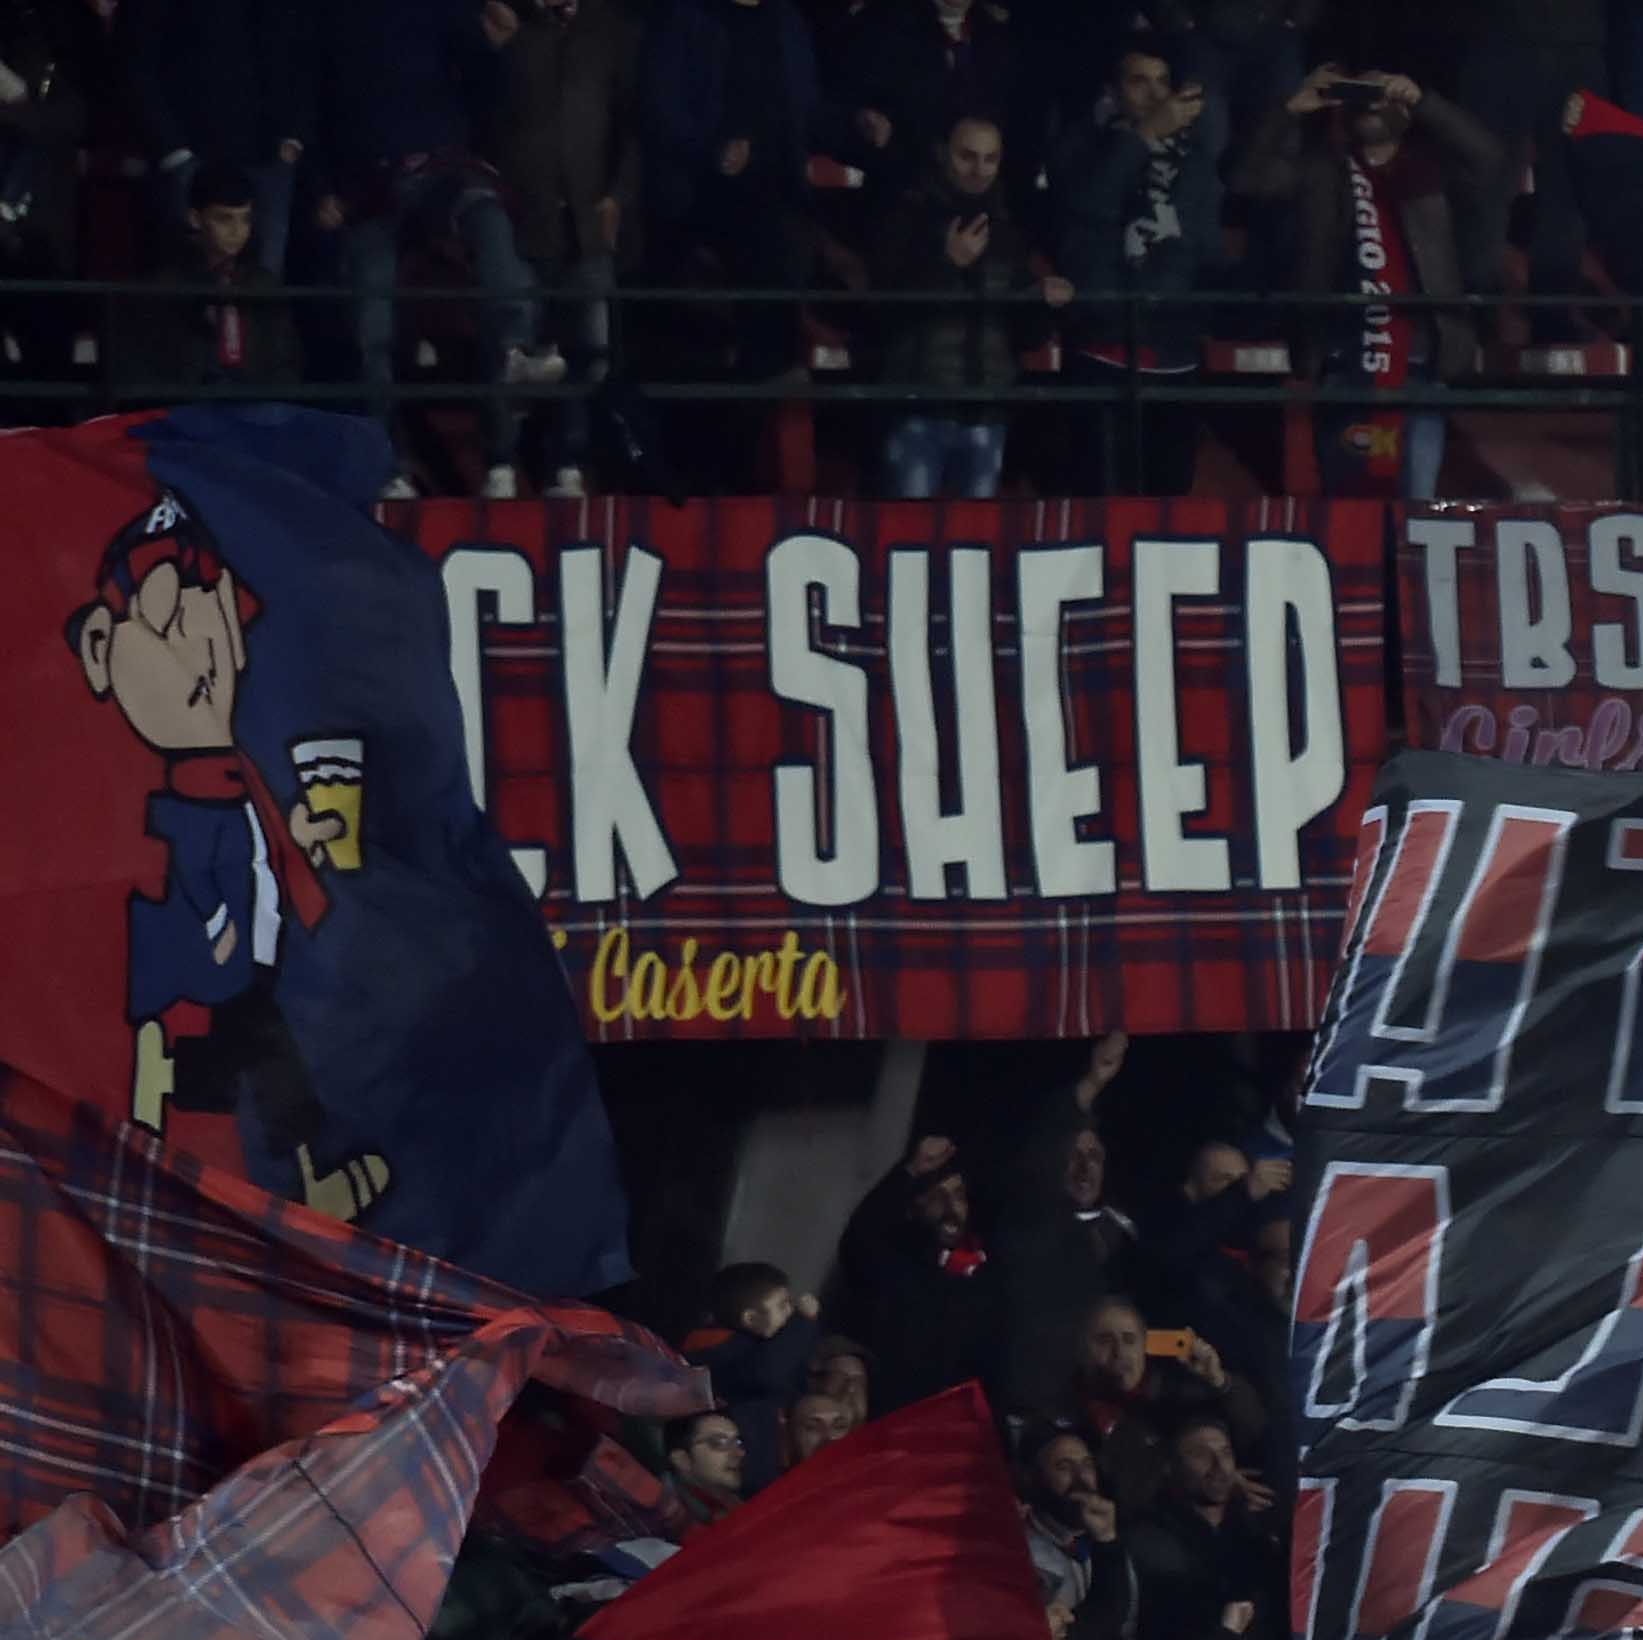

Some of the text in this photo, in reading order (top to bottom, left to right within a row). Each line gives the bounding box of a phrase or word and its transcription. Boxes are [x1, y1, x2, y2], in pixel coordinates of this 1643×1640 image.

[443, 533, 1345, 905] CK SHEEP
[590, 927, 848, 1027] Caserta
